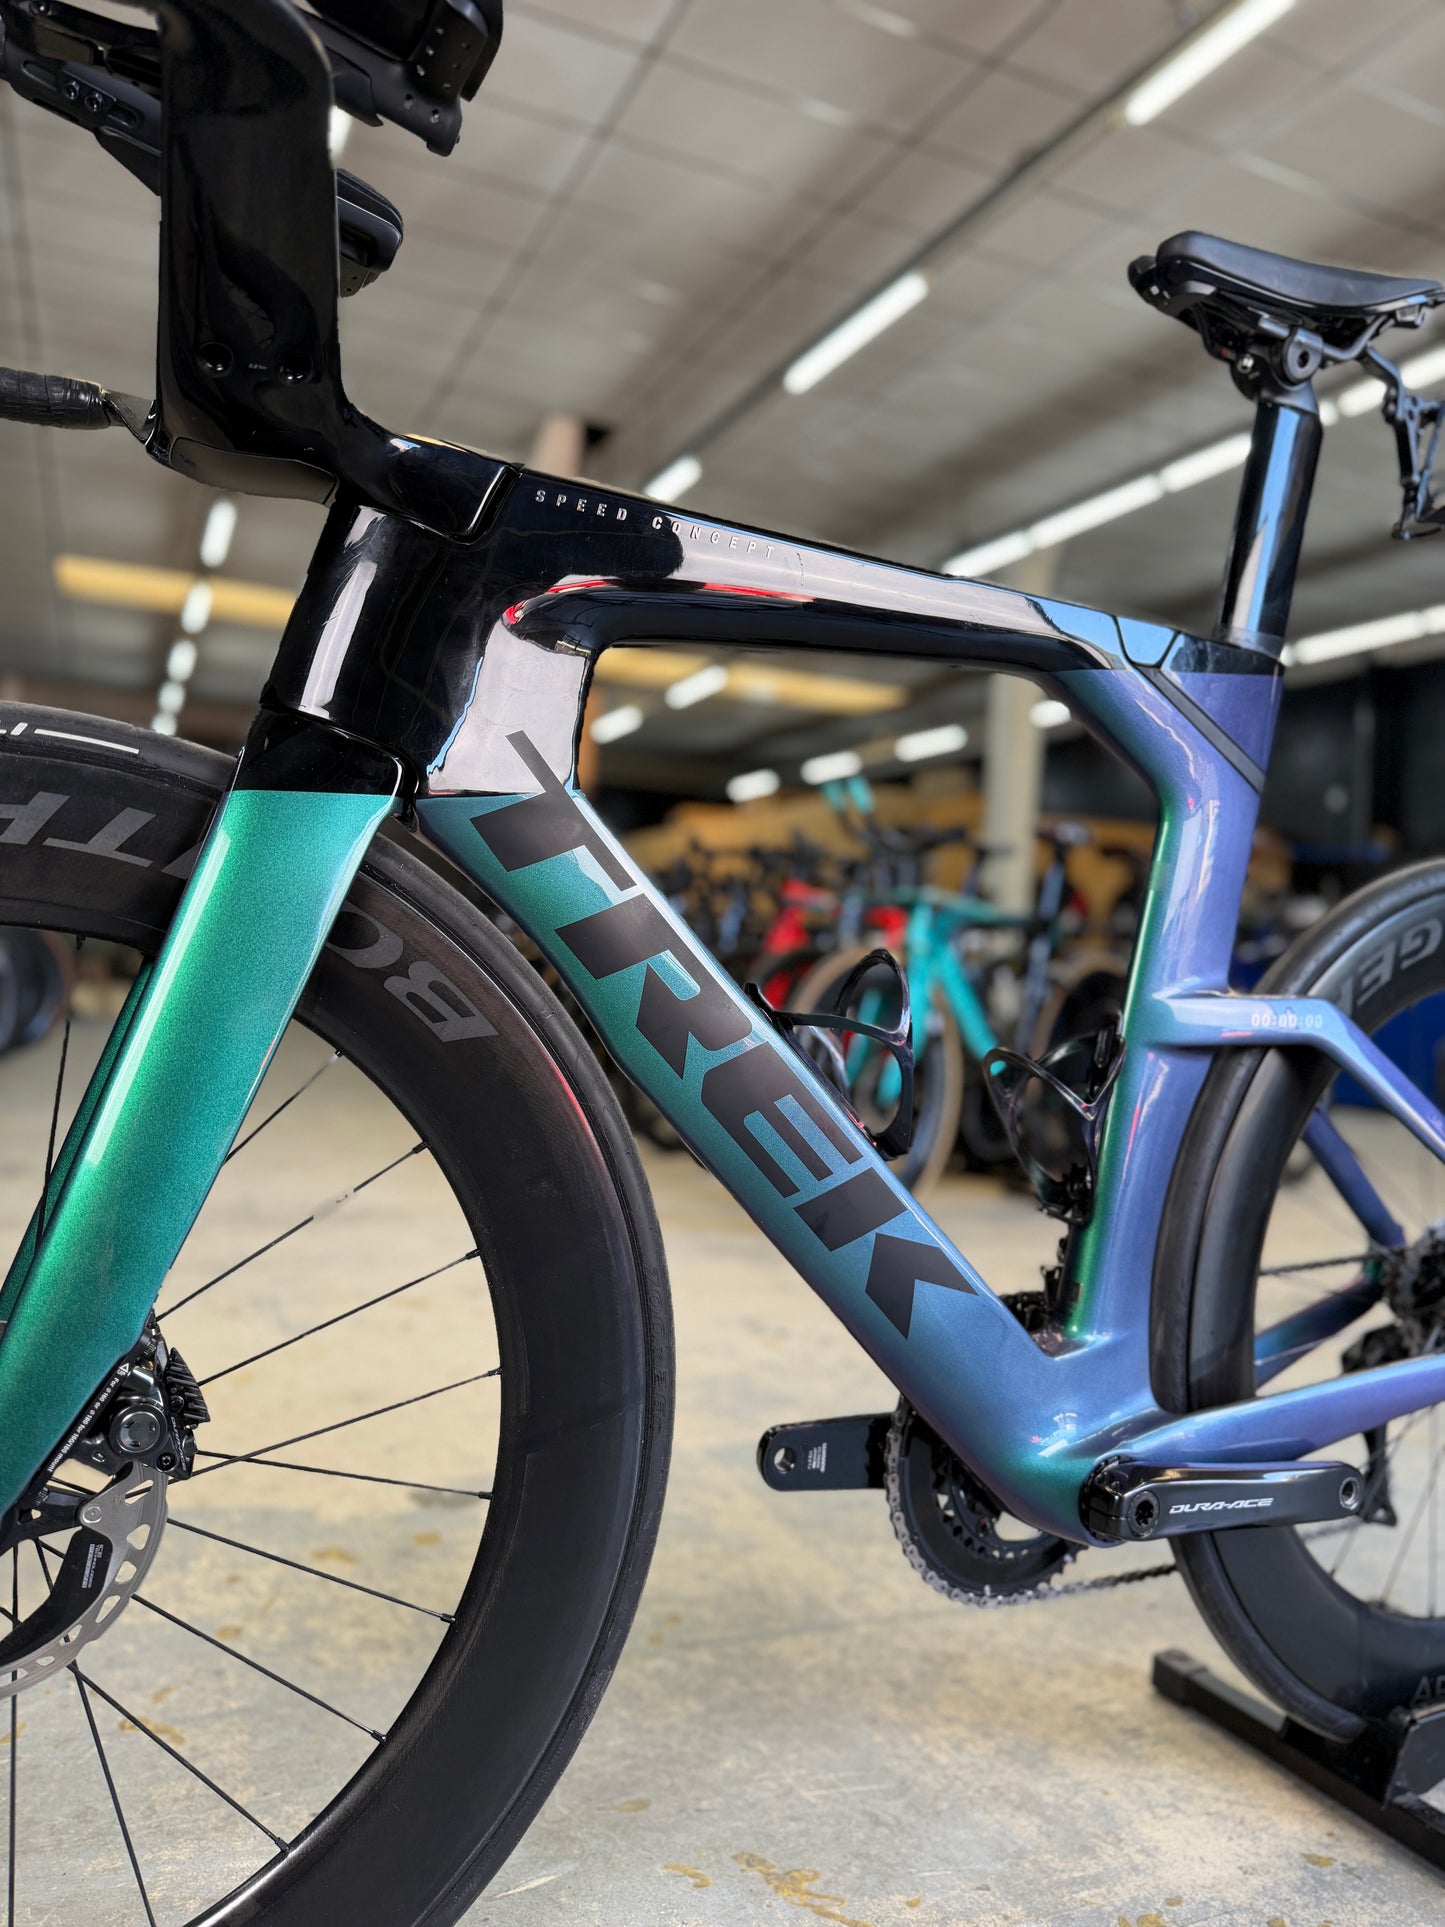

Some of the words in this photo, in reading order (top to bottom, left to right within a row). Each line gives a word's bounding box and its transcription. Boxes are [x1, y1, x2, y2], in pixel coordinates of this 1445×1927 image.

[535, 489, 628, 521] SPEED
[652, 516, 775, 559] CONCEPT
[470, 730, 980, 1340] TREK
[110, 1377, 120, 1388] For
[47, 1452, 63, 1472] mount
[1169, 1497, 1274, 1514] DURA-ACE
